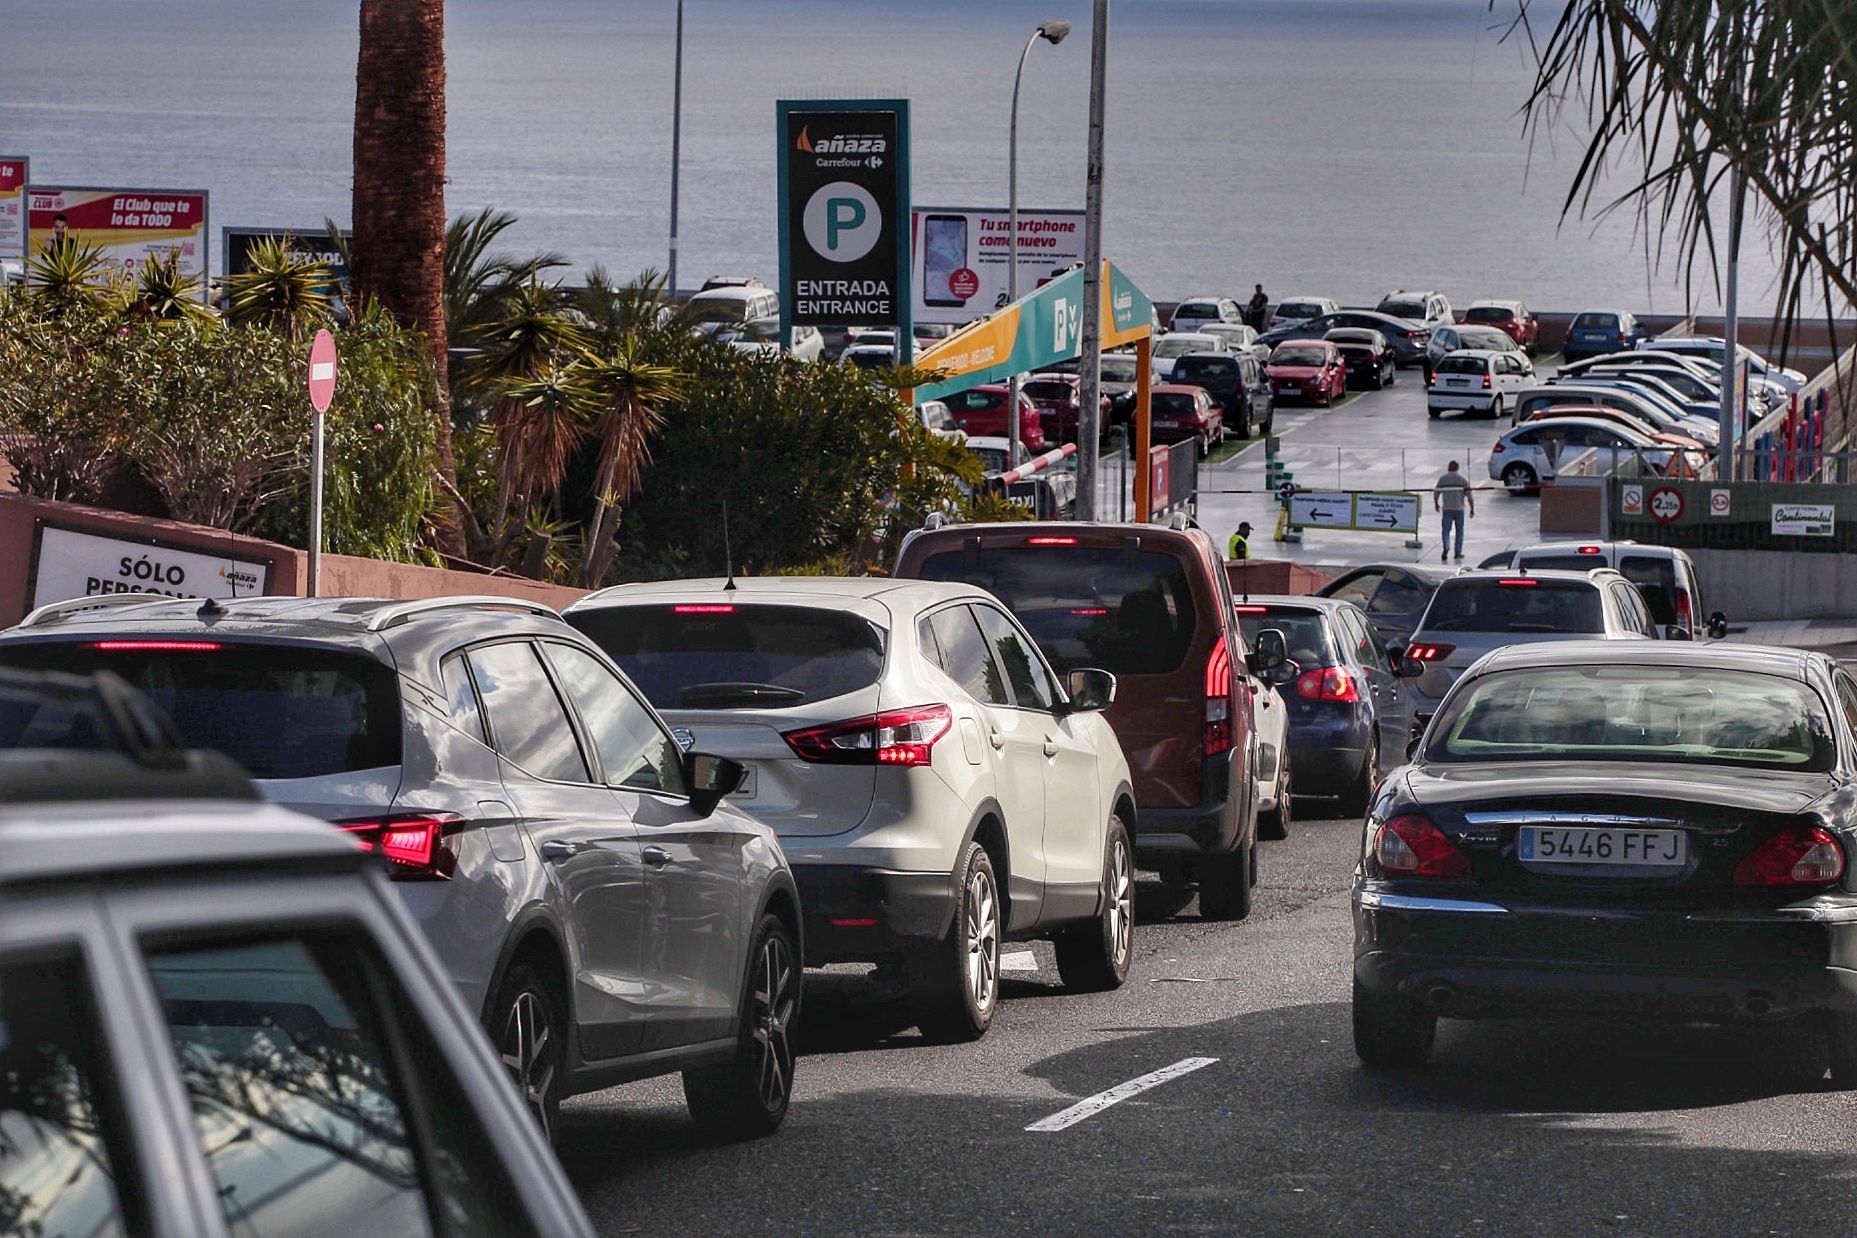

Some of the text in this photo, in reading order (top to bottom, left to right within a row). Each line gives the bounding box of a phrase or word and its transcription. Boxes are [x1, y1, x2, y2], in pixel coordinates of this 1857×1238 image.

[815, 134, 887, 153] añaza
[816, 157, 861, 168] Carrefour
[113, 199, 190, 216] El Club que te
[111, 213, 172, 227] lo da TODO
[827, 198, 867, 251] P
[980, 219, 995, 230] Tu
[1017, 236, 1057, 248] nuevo
[797, 280, 890, 296] ENTRADA
[797, 300, 890, 314] ENTRANCE
[1776, 509, 1833, 523] Continental
[119, 554, 185, 586] SÓLO
[1540, 831, 1678, 860] 5446 FFJ
